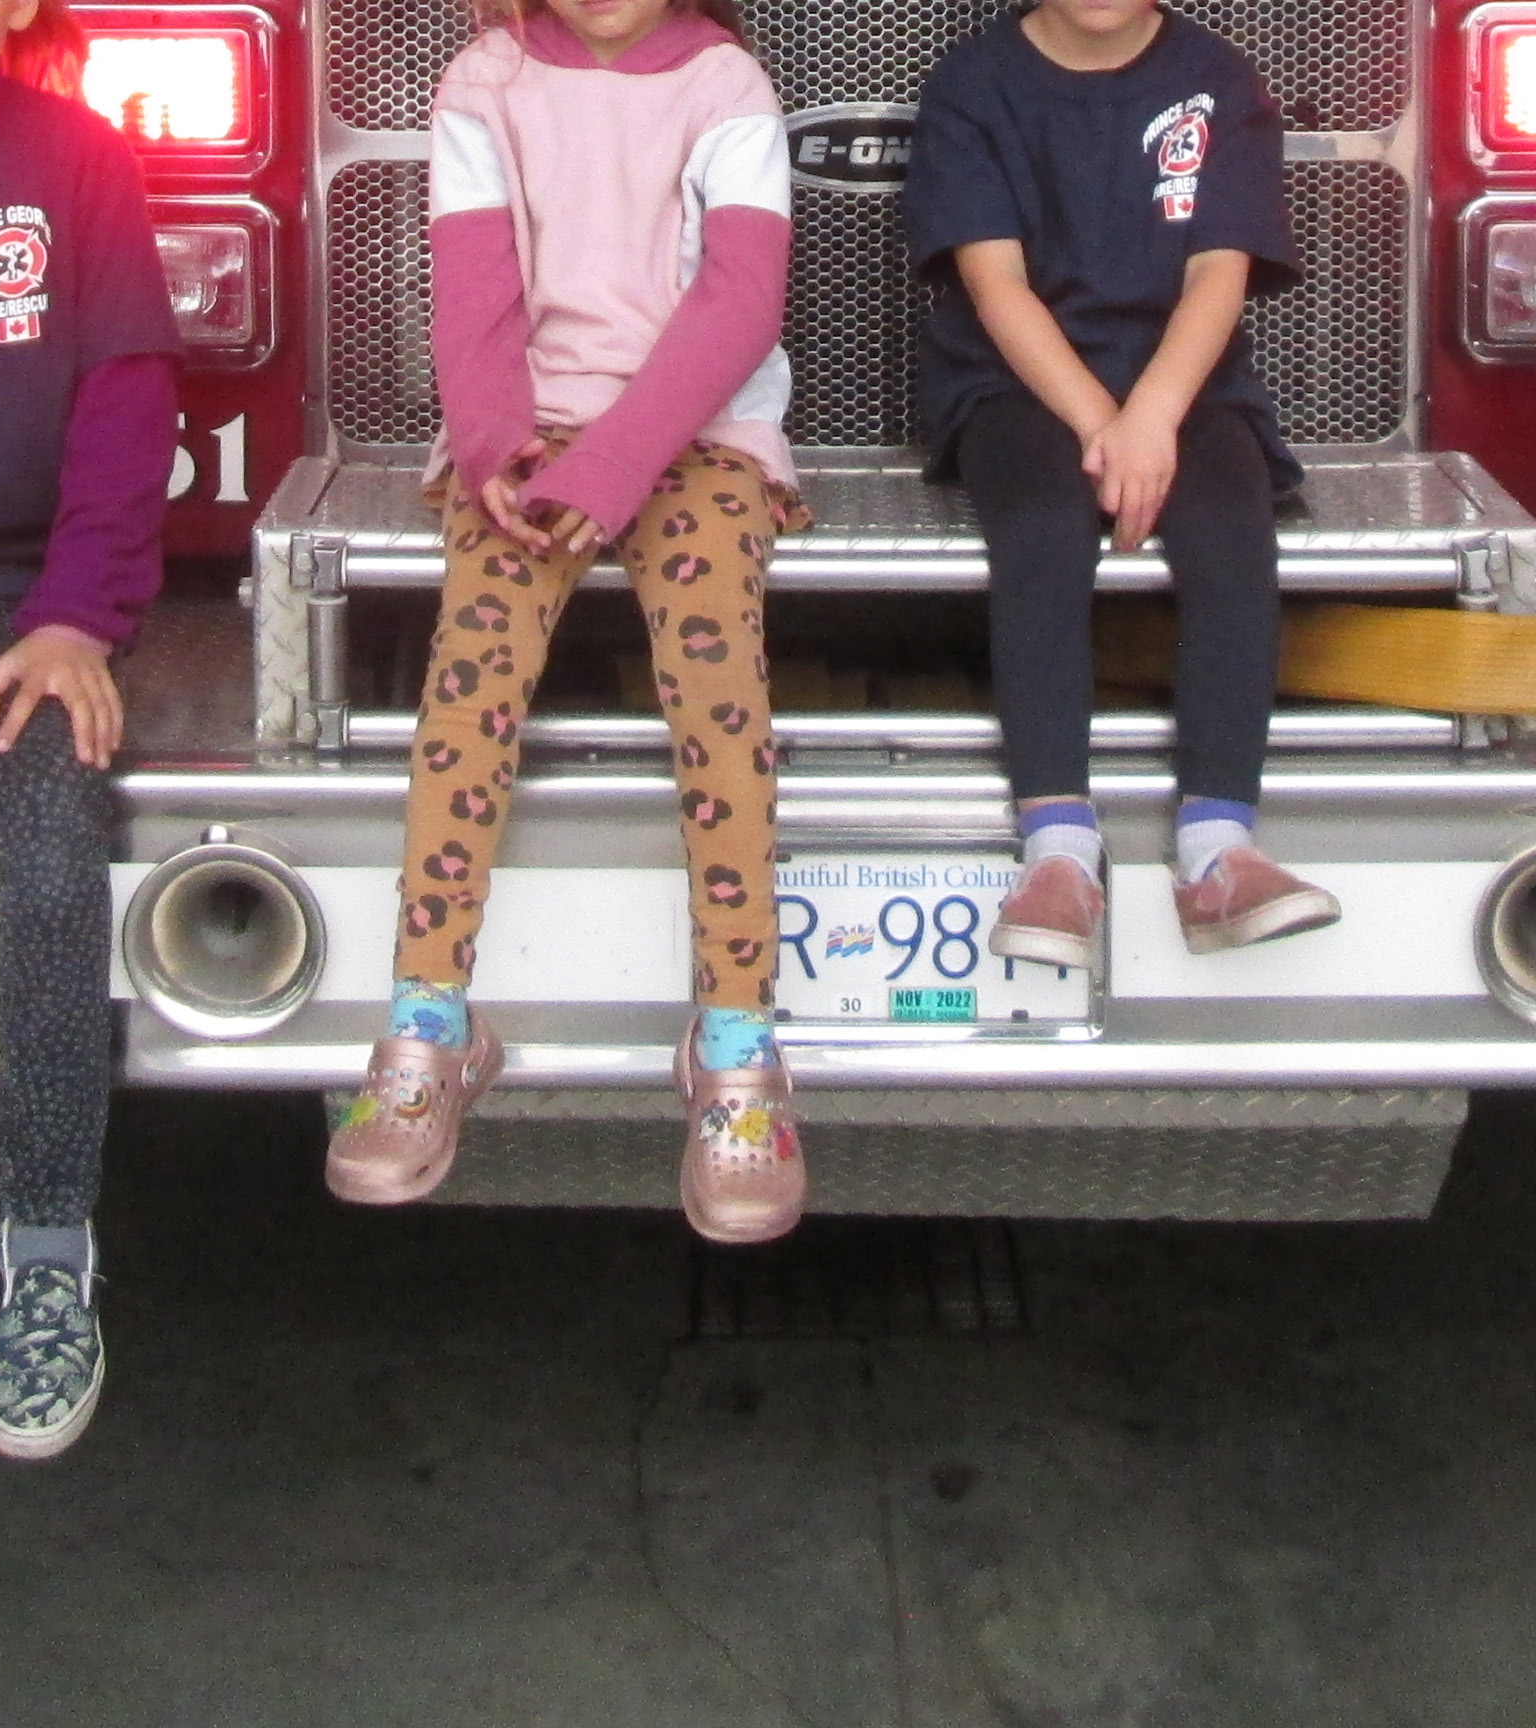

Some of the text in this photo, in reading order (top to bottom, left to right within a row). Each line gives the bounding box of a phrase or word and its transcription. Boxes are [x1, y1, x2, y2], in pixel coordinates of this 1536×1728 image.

[1142, 102, 1184, 154] PRINCE
[6, 205, 52, 246] GEOR
[856, 864, 936, 888] British
[840, 990, 971, 1013] 30 NOV 2022
